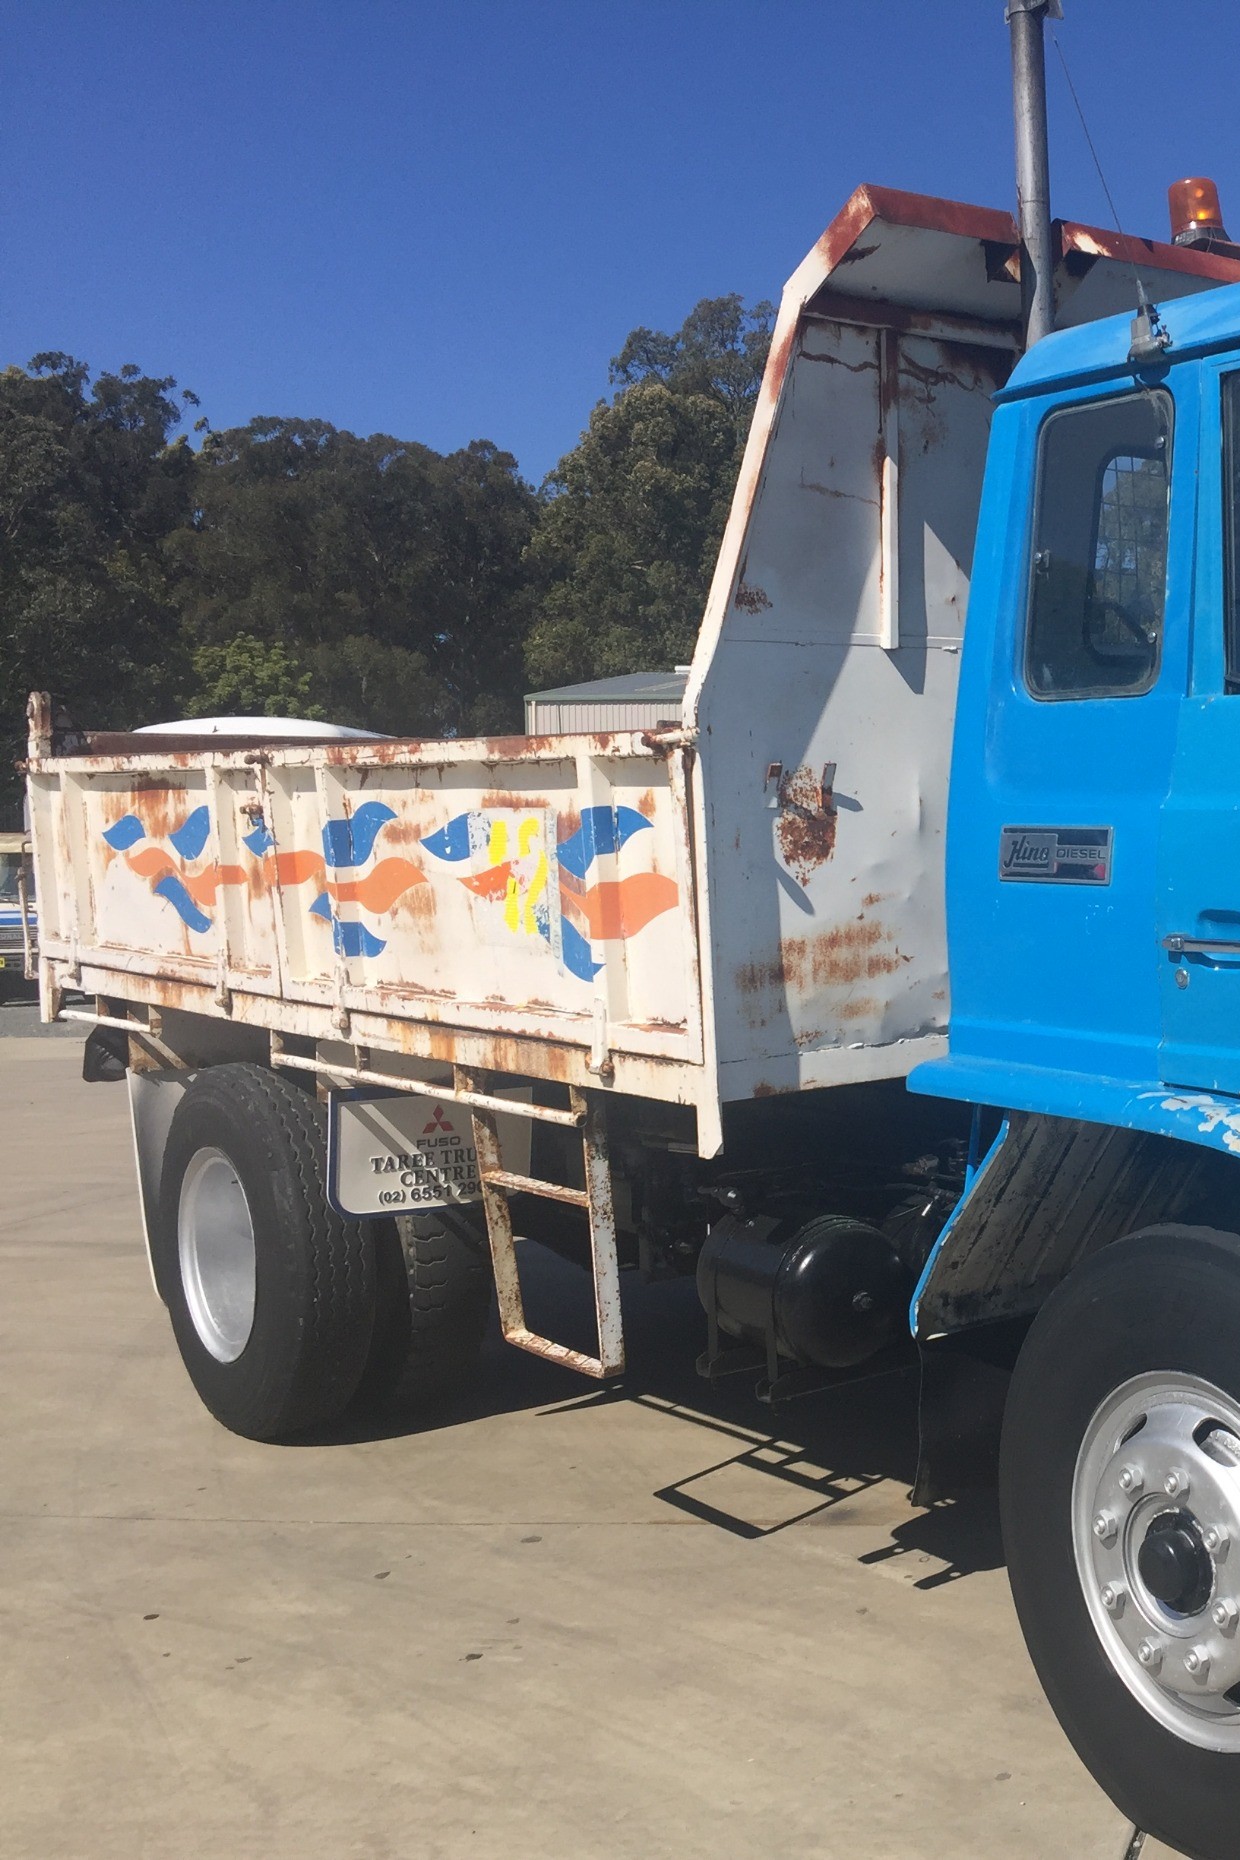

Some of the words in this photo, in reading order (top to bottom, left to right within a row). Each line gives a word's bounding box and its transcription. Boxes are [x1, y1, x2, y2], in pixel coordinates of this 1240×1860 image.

[1003, 835, 1050, 868] Hino
[1056, 848, 1106, 860] DIESEL
[416, 1135, 461, 1149] FUSO
[370, 1151, 435, 1174] TAREE
[440, 1146, 477, 1165] TRU
[401, 1164, 476, 1187] CENTRE
[378, 1189, 406, 1206] (02)
[411, 1184, 452, 1202] 6551
